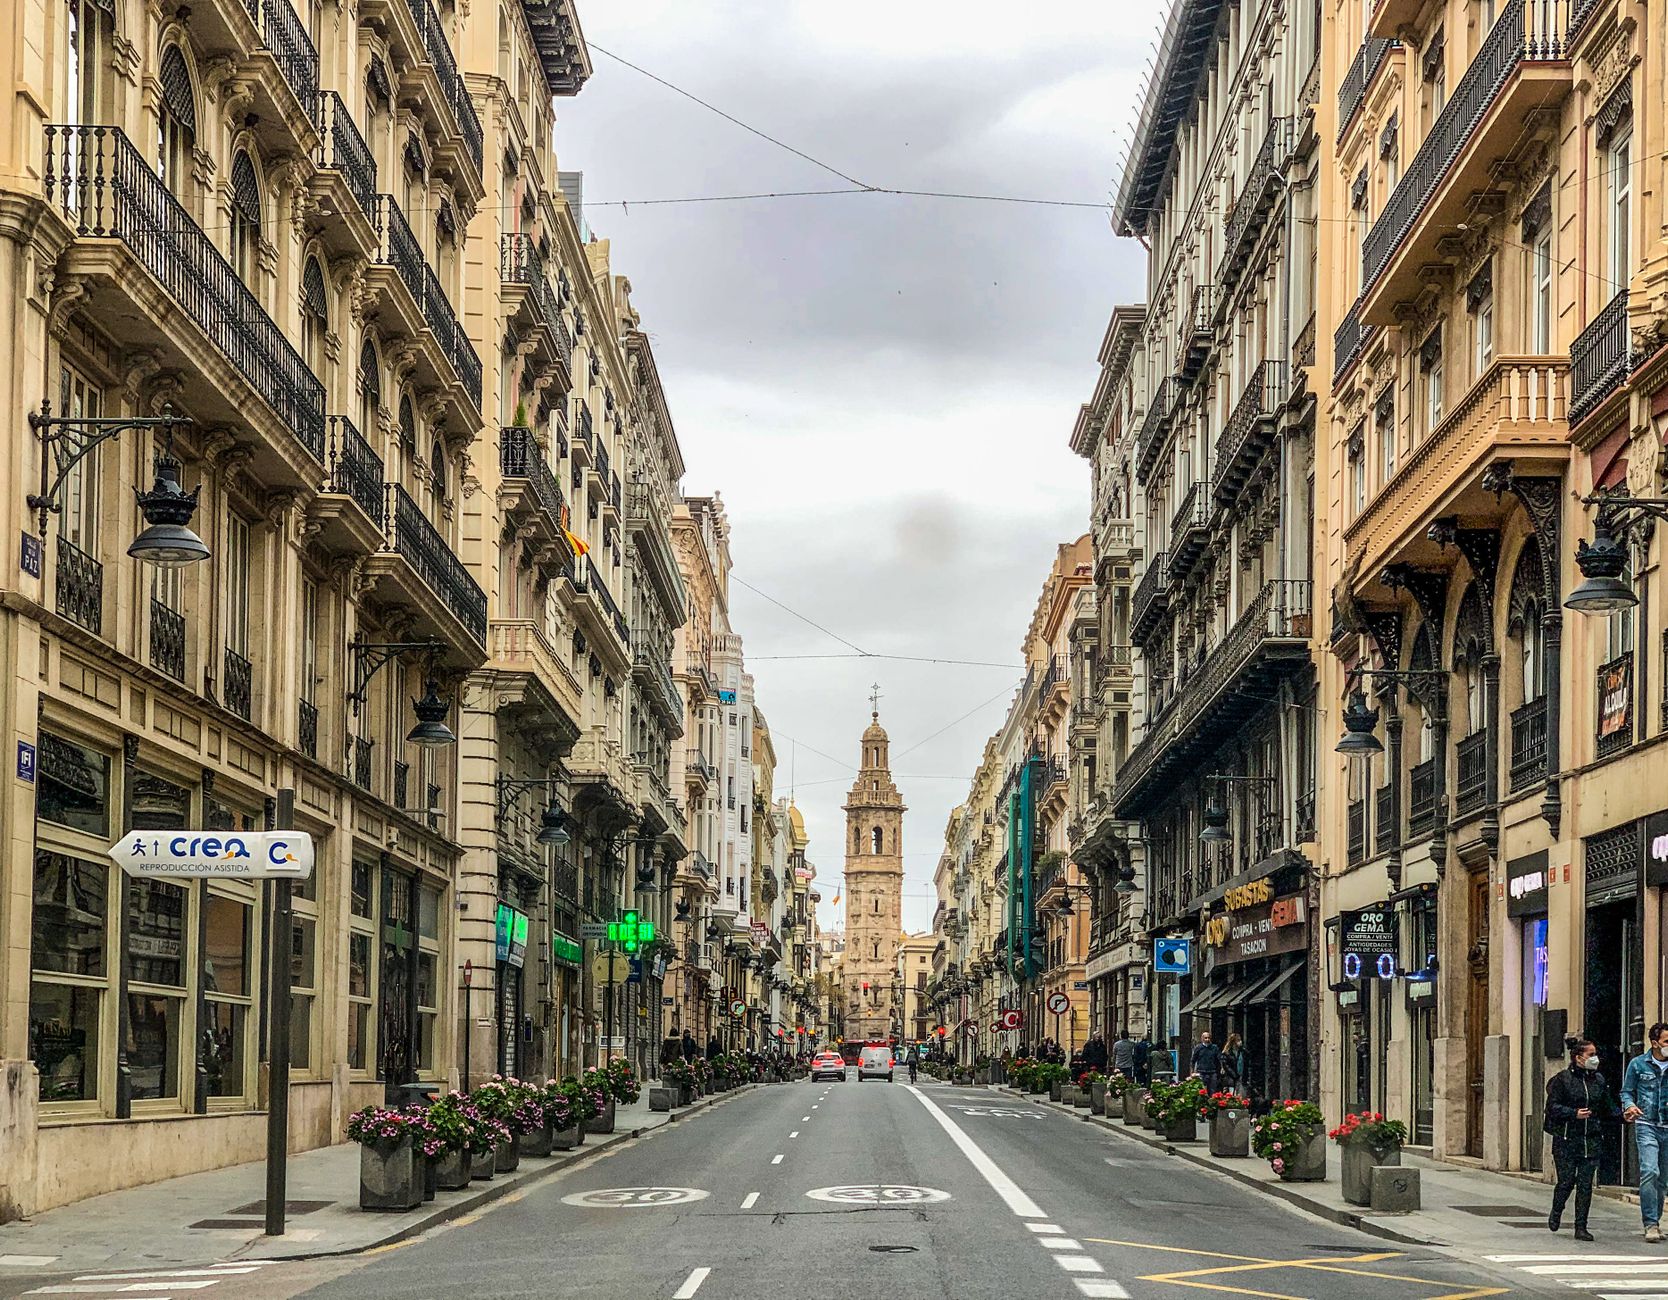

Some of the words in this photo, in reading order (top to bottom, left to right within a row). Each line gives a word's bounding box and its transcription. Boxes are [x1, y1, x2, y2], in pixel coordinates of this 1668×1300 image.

[169, 837, 250, 859] crea
[139, 862, 212, 872] REPRODUCCIÓN
[214, 864, 250, 873] ASISTIDA
[1224, 877, 1270, 912] SUBASTAS
[1361, 913, 1384, 924] ORO
[1232, 922, 1254, 940] COMPRA
[1353, 923, 1385, 932] GEMA
